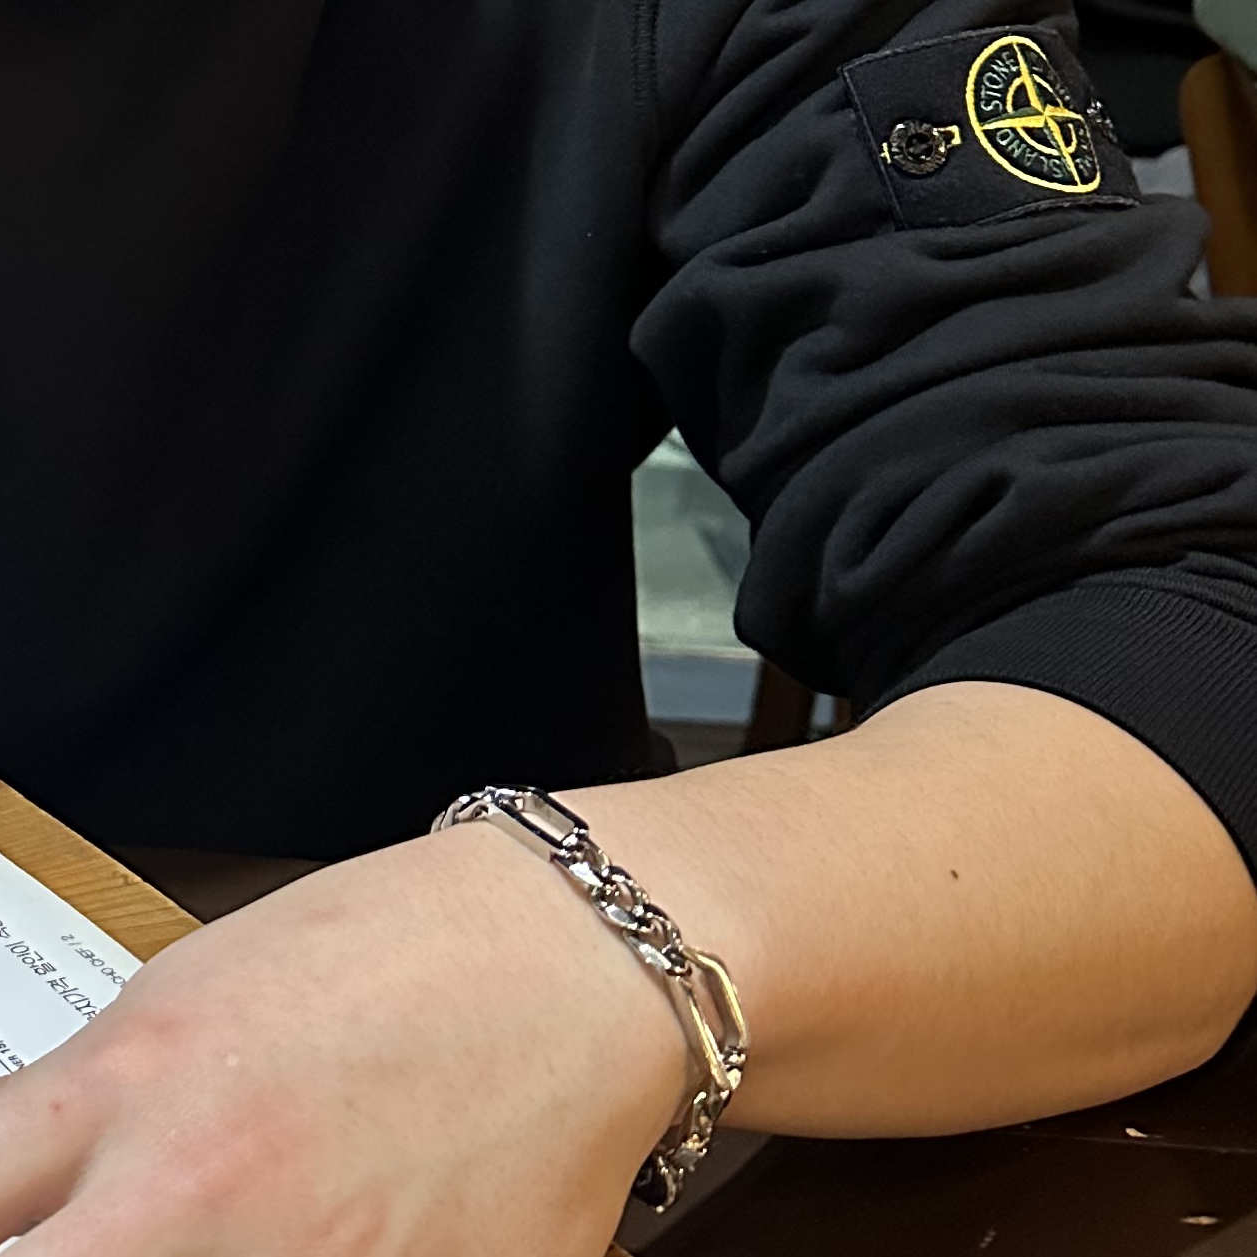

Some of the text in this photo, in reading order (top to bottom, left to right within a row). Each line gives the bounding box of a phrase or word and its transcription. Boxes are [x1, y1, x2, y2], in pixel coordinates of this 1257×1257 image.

[980, 52, 1019, 113] STONE
[59, 933, 74, 941] 2
[4, 940, 56, 975] 할인이
[75, 948, 104, 967] CHEF
